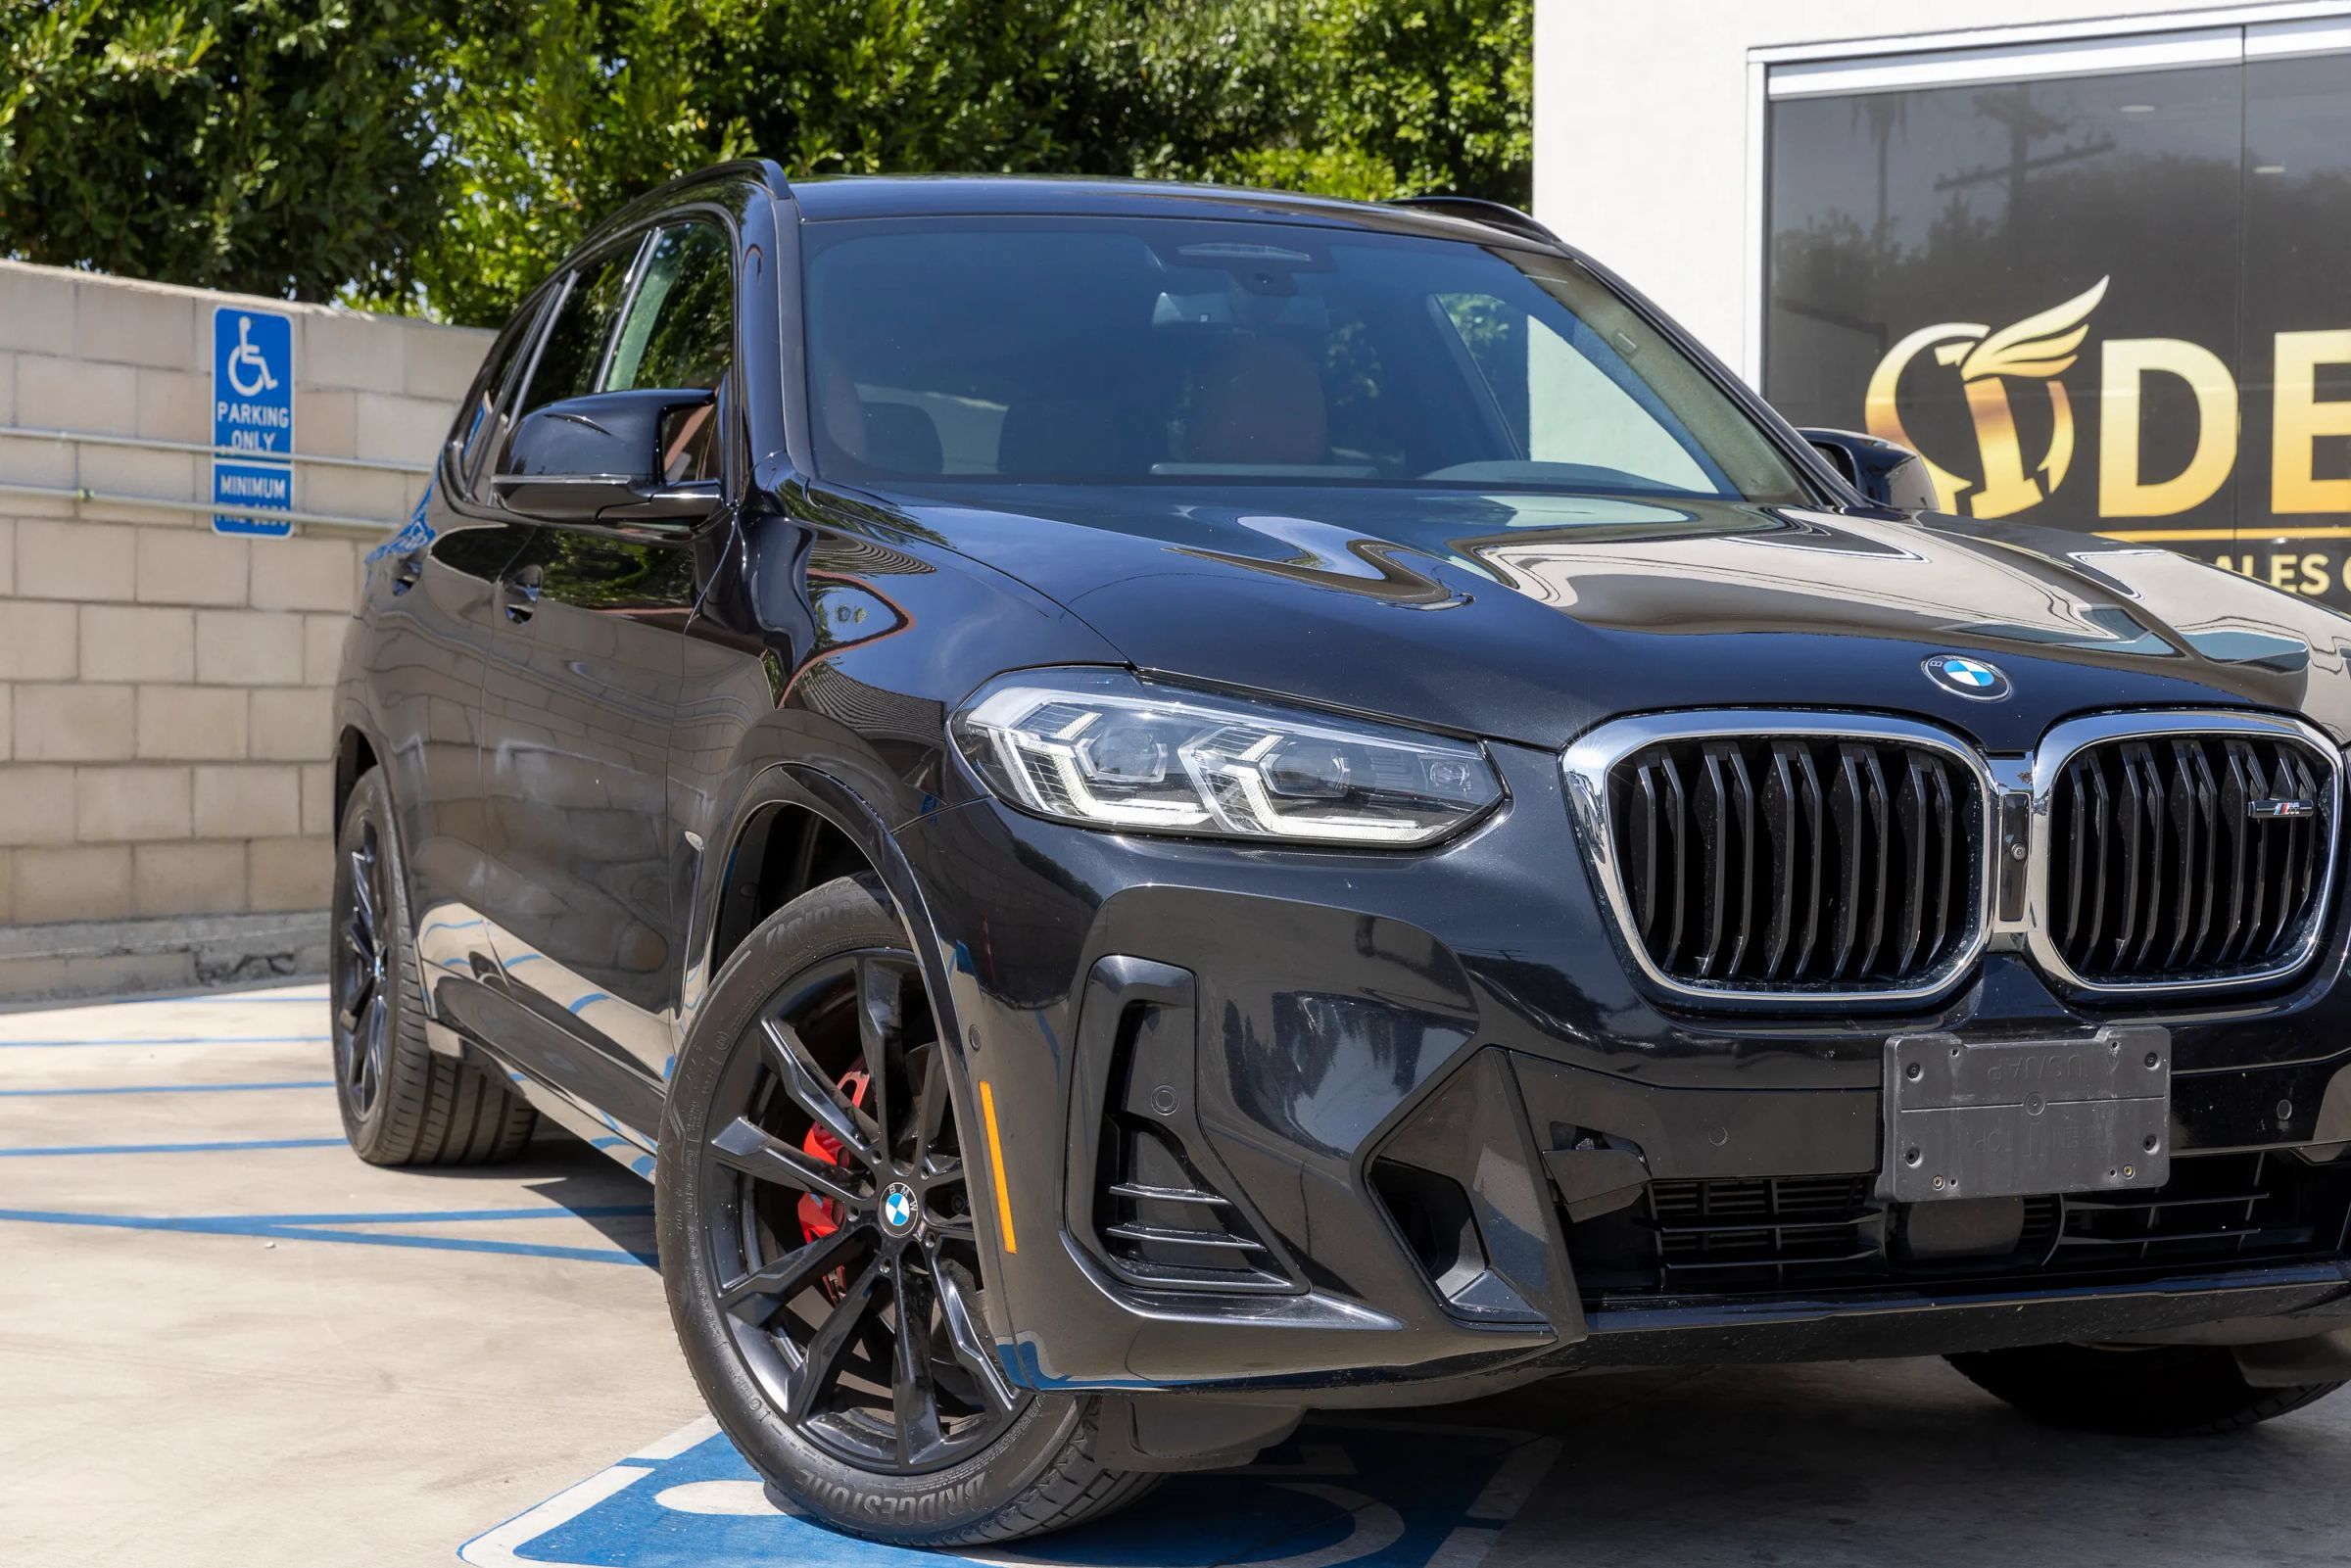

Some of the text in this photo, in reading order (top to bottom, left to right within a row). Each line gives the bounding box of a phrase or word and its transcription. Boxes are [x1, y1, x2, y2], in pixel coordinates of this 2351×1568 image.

[217, 401, 289, 428] PARKING
[231, 430, 276, 451] ONLY
[220, 475, 286, 499] MINIMUM
[888, 1184, 918, 1212] BMW
[793, 1467, 986, 1525] BRIDGESTONE
